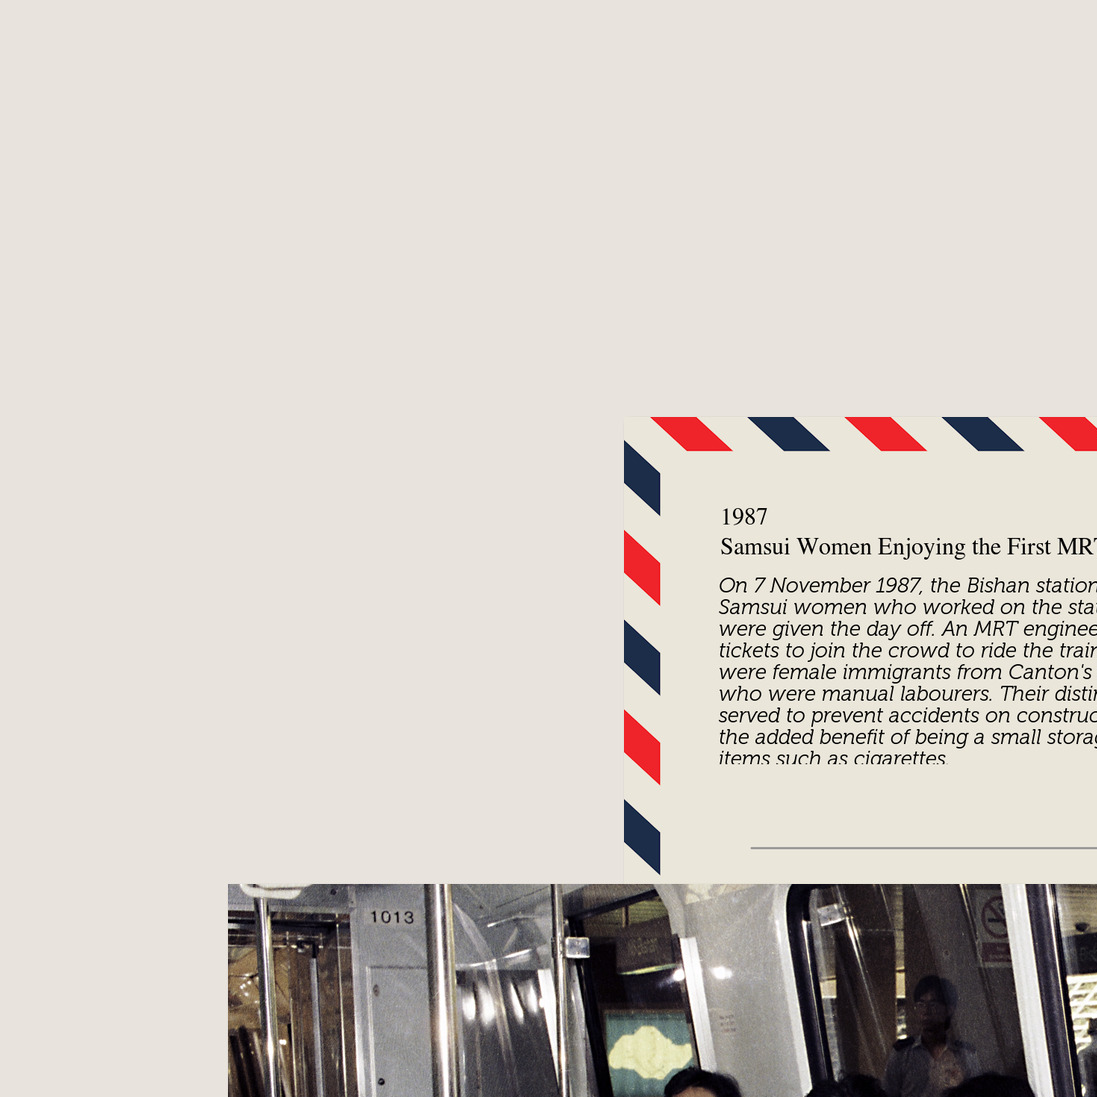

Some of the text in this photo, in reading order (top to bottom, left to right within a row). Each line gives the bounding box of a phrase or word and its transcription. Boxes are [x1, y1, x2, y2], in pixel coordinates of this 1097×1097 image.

[723, 508, 767, 526] 1987
[721, 538, 790, 555] Samsui
[796, 538, 871, 555] Women
[878, 538, 966, 560] Enjoying
[972, 538, 1001, 555] the
[1007, 538, 1051, 555] First
[719, 577, 747, 593] On
[755, 577, 766, 593] 7
[770, 577, 871, 593] November
[876, 577, 922, 595] 1987,
[931, 577, 960, 593] the
[968, 577, 1029, 593] Bishan
[719, 599, 787, 614] Samsui
[794, 603, 866, 615] women
[874, 599, 916, 614] who
[923, 599, 995, 614] worked
[1000, 603, 1025, 614] on
[1033, 599, 1062, 614] the
[719, 624, 766, 636] were
[772, 621, 823, 641] given
[831, 620, 860, 636] the
[867, 620, 902, 641] day
[907, 620, 934, 636] off.
[941, 620, 967, 636] An
[973, 620, 1019, 636] MRT
[720, 642, 779, 658] tickets
[786, 643, 804, 658] to
[807, 642, 845, 662] join
[853, 642, 882, 658] the
[888, 642, 950, 658] crowd
[956, 643, 974, 658] to
[981, 642, 1016, 658] ride
[1024, 642, 1053, 658] the
[719, 668, 766, 679] were
[773, 664, 836, 679] female
[843, 664, 951, 684] immigrants
[957, 664, 1001, 679] from
[1009, 664, 1092, 679] Canton's
[719, 685, 762, 701] who
[769, 689, 815, 701] were
[822, 685, 894, 701] manual
[901, 685, 992, 701] labourers.
[1001, 685, 1050, 701] Their
[718, 707, 780, 723] served
[787, 708, 805, 723] to
[811, 708, 883, 727] prevent
[889, 707, 979, 723] accidents
[985, 711, 1010, 723] on
[720, 729, 749, 744] the
[755, 729, 814, 744] added
[820, 729, 885, 744] benefit
[891, 729, 911, 744] of
[915, 729, 969, 749] being
[974, 732, 984, 744] a
[991, 729, 1041, 744] small
[719, 751, 770, 765] items
[776, 750, 821, 765] such
[828, 754, 848, 765] as
[370, 910, 414, 924] 1013
